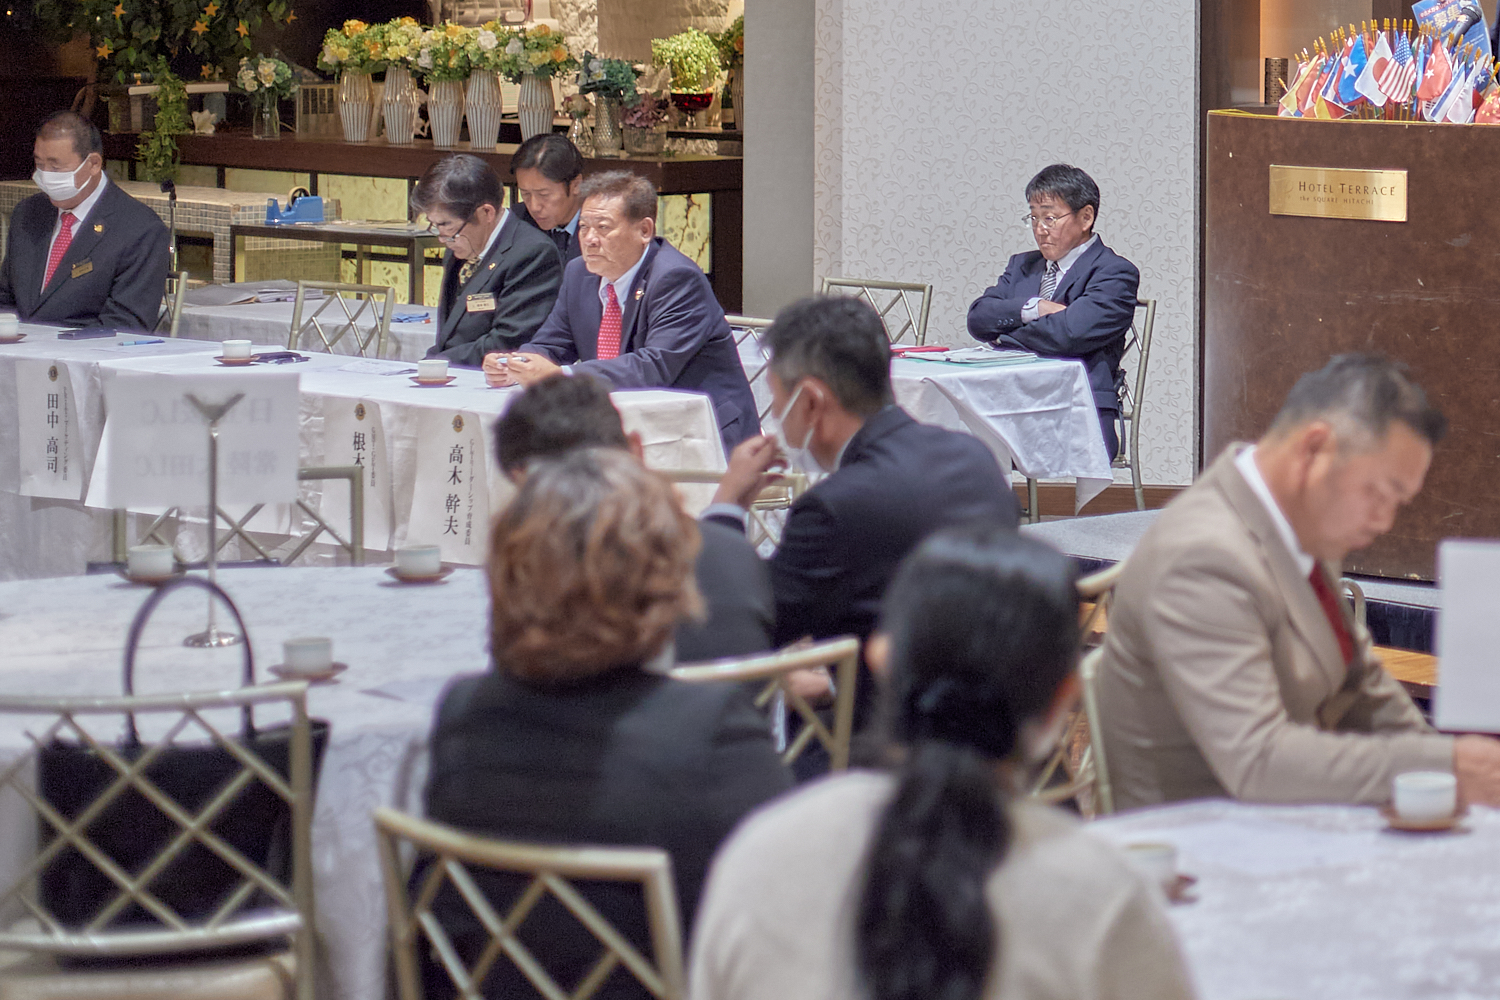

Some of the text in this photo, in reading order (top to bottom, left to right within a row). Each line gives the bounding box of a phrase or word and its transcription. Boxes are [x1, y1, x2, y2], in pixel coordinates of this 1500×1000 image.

[1299, 181, 1396, 196] HOTEL TERRACE
[46, 393, 59, 474] 田中 高司
[443, 443, 464, 535] 高木 幹夫
